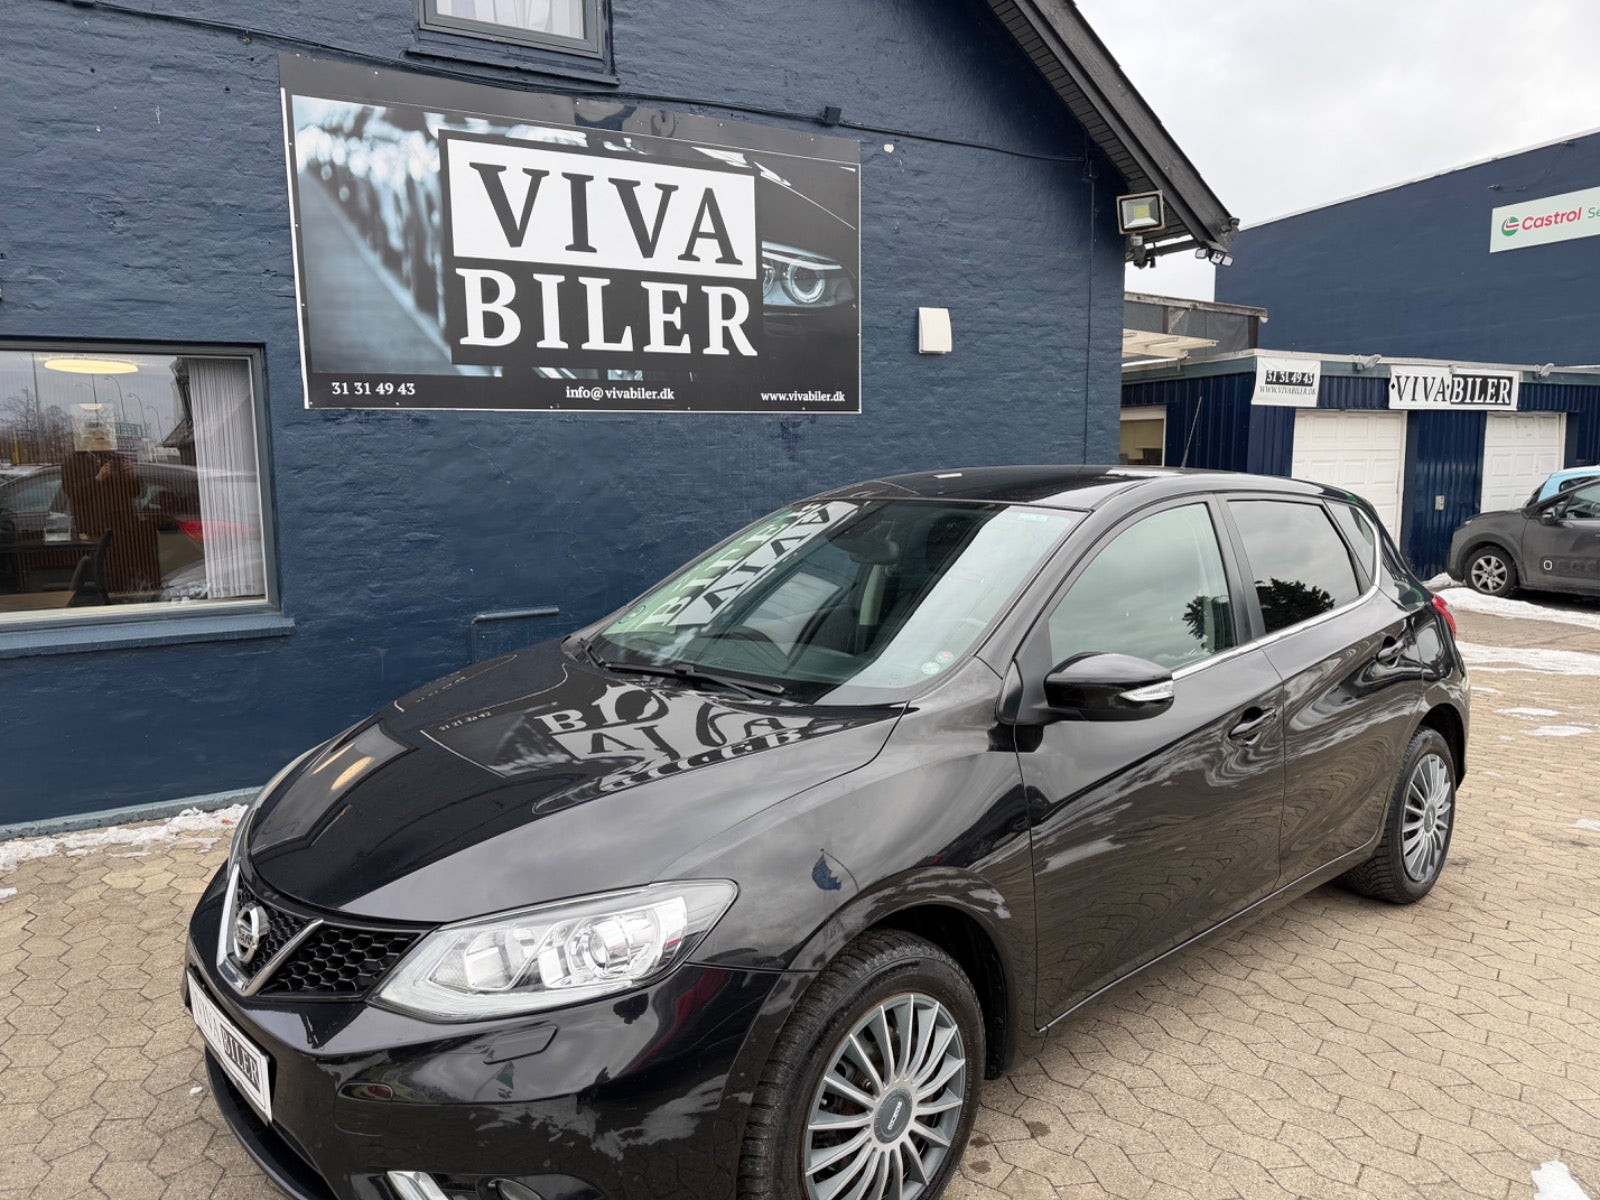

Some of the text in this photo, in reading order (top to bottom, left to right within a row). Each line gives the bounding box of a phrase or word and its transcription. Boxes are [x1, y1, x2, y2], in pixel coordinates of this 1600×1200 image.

[469, 162, 743, 265] VIVA
[1521, 207, 1582, 230] Castrol
[455, 267, 758, 356] BILER
[331, 382, 416, 395] 31 31 49 43
[1266, 370, 1314, 384] 31 31 49 43
[1395, 375, 1511, 404] VIVA BILER
[760, 390, 845, 402] www.vivabiler.dk
[221, 1027, 260, 1089] BILER
